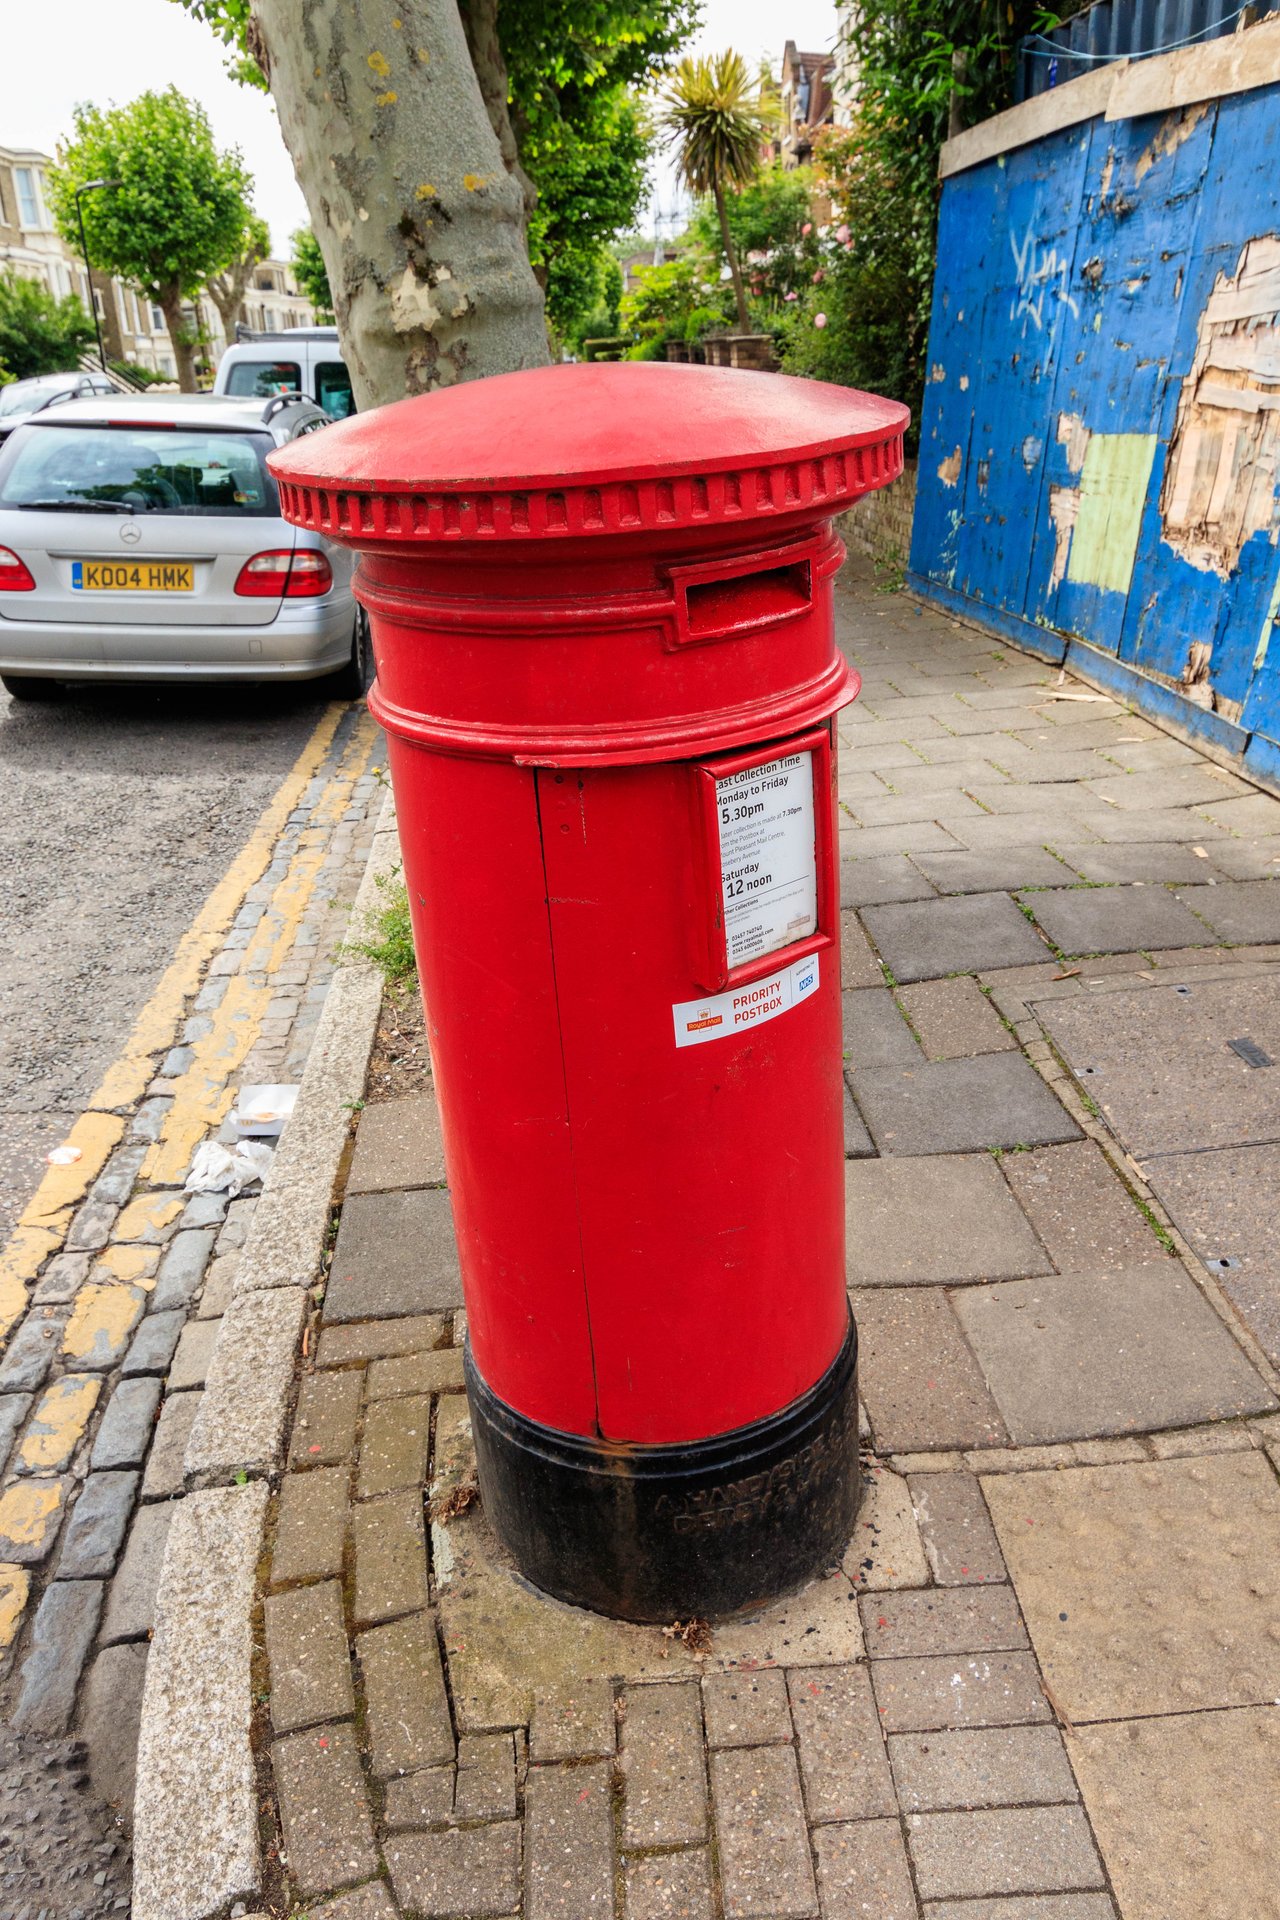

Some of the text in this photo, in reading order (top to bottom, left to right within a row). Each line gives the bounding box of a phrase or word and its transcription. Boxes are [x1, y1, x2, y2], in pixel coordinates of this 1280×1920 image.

[149, 567, 189, 588] HMK
[716, 755, 801, 790] ast Collection Time
[751, 786, 760, 796] to
[762, 776, 788, 792] Friday
[722, 802, 764, 825] 5.30pm
[733, 821, 757, 836] collection
[757, 819, 763, 827] is
[762, 815, 776, 825] made
[776, 812, 783, 821] at
[782, 806, 803, 818] 7.30pm
[720, 848, 735, 859] ount
[735, 840, 757, 854] Pleasant
[757, 835, 768, 846] Mail
[730, 836, 739, 846] the
[739, 830, 759, 842] Postbox
[760, 828, 766, 836] at
[722, 849, 761, 868] osebery Avenue
[721, 862, 760, 883] Saturday
[726, 874, 772, 899] 12 noon
[735, 898, 759, 912] Collections
[731, 927, 774, 948] www.royalmail.com
[800, 973, 814, 991] NHS
[733, 980, 782, 1010] PRIORITY
[734, 995, 783, 1025] POSTBOX
[688, 1017, 722, 1030] Royal Mail
